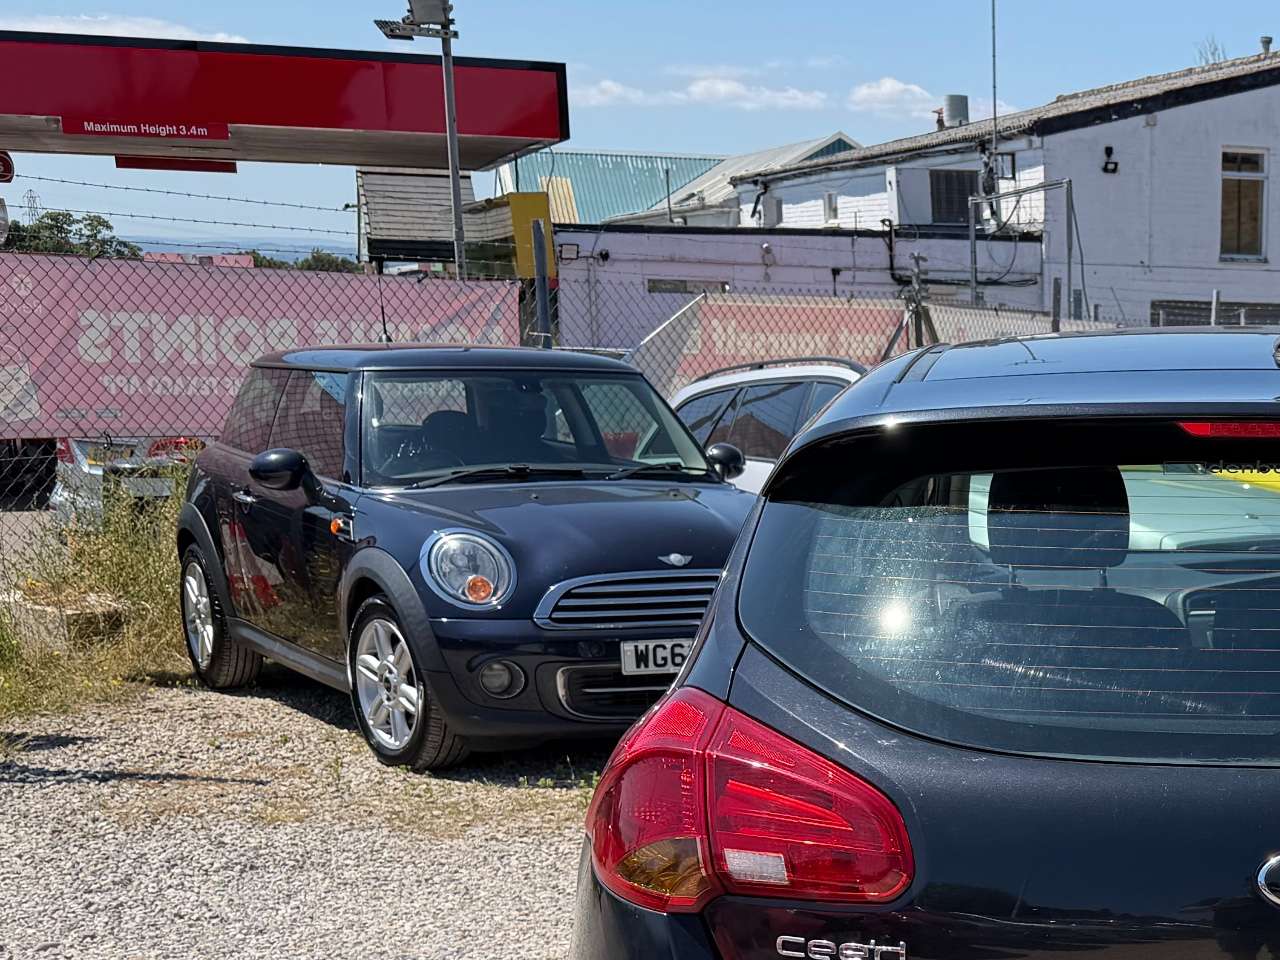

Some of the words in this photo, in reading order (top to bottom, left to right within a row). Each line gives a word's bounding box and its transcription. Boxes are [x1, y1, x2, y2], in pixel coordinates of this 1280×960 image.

[84, 121, 138, 133] Maximum
[140, 123, 178, 137] Height
[179, 125, 208, 136] 3.4m
[634, 643, 689, 669] WG6
